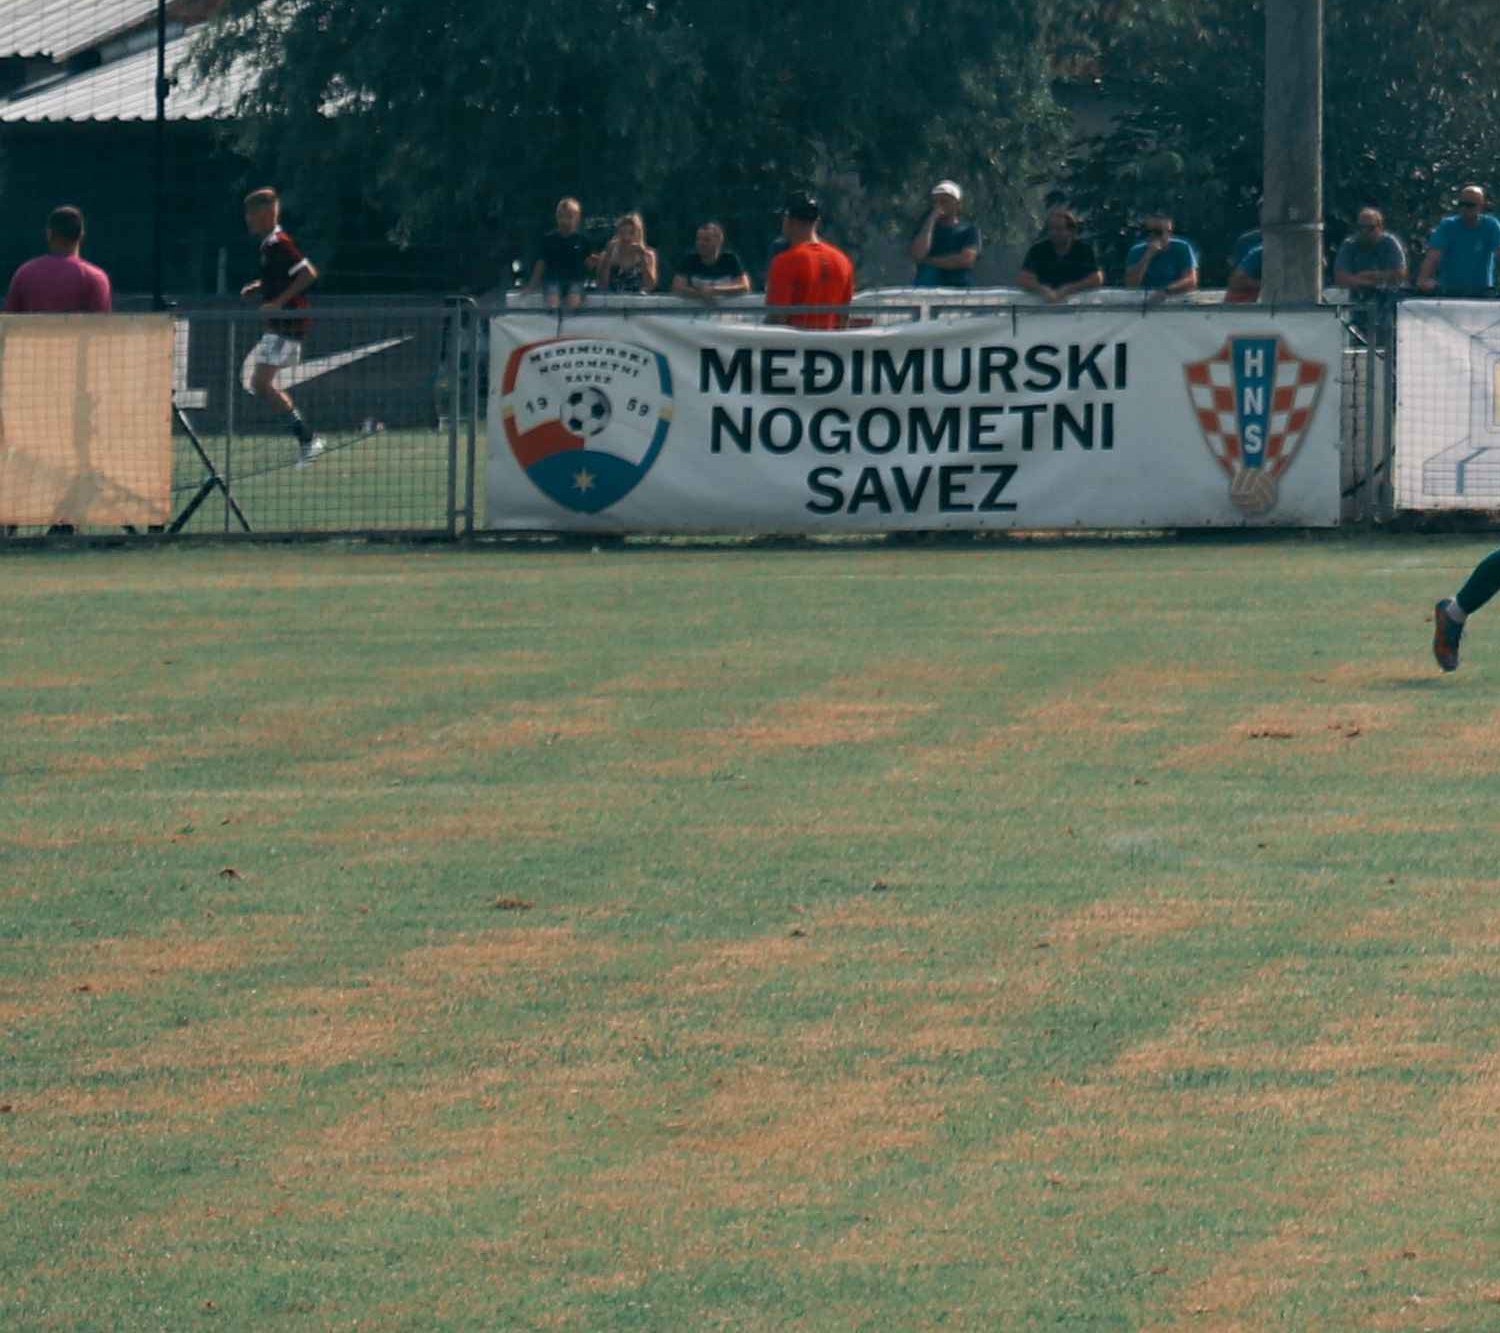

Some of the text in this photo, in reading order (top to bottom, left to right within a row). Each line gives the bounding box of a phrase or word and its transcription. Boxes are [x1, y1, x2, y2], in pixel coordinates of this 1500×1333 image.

[699, 342, 1127, 395] MEĐIMURSKI
[1243, 349, 1264, 454] HNS
[710, 402, 1115, 455] NOGOMETNI
[806, 464, 1019, 514] SAVEZ
